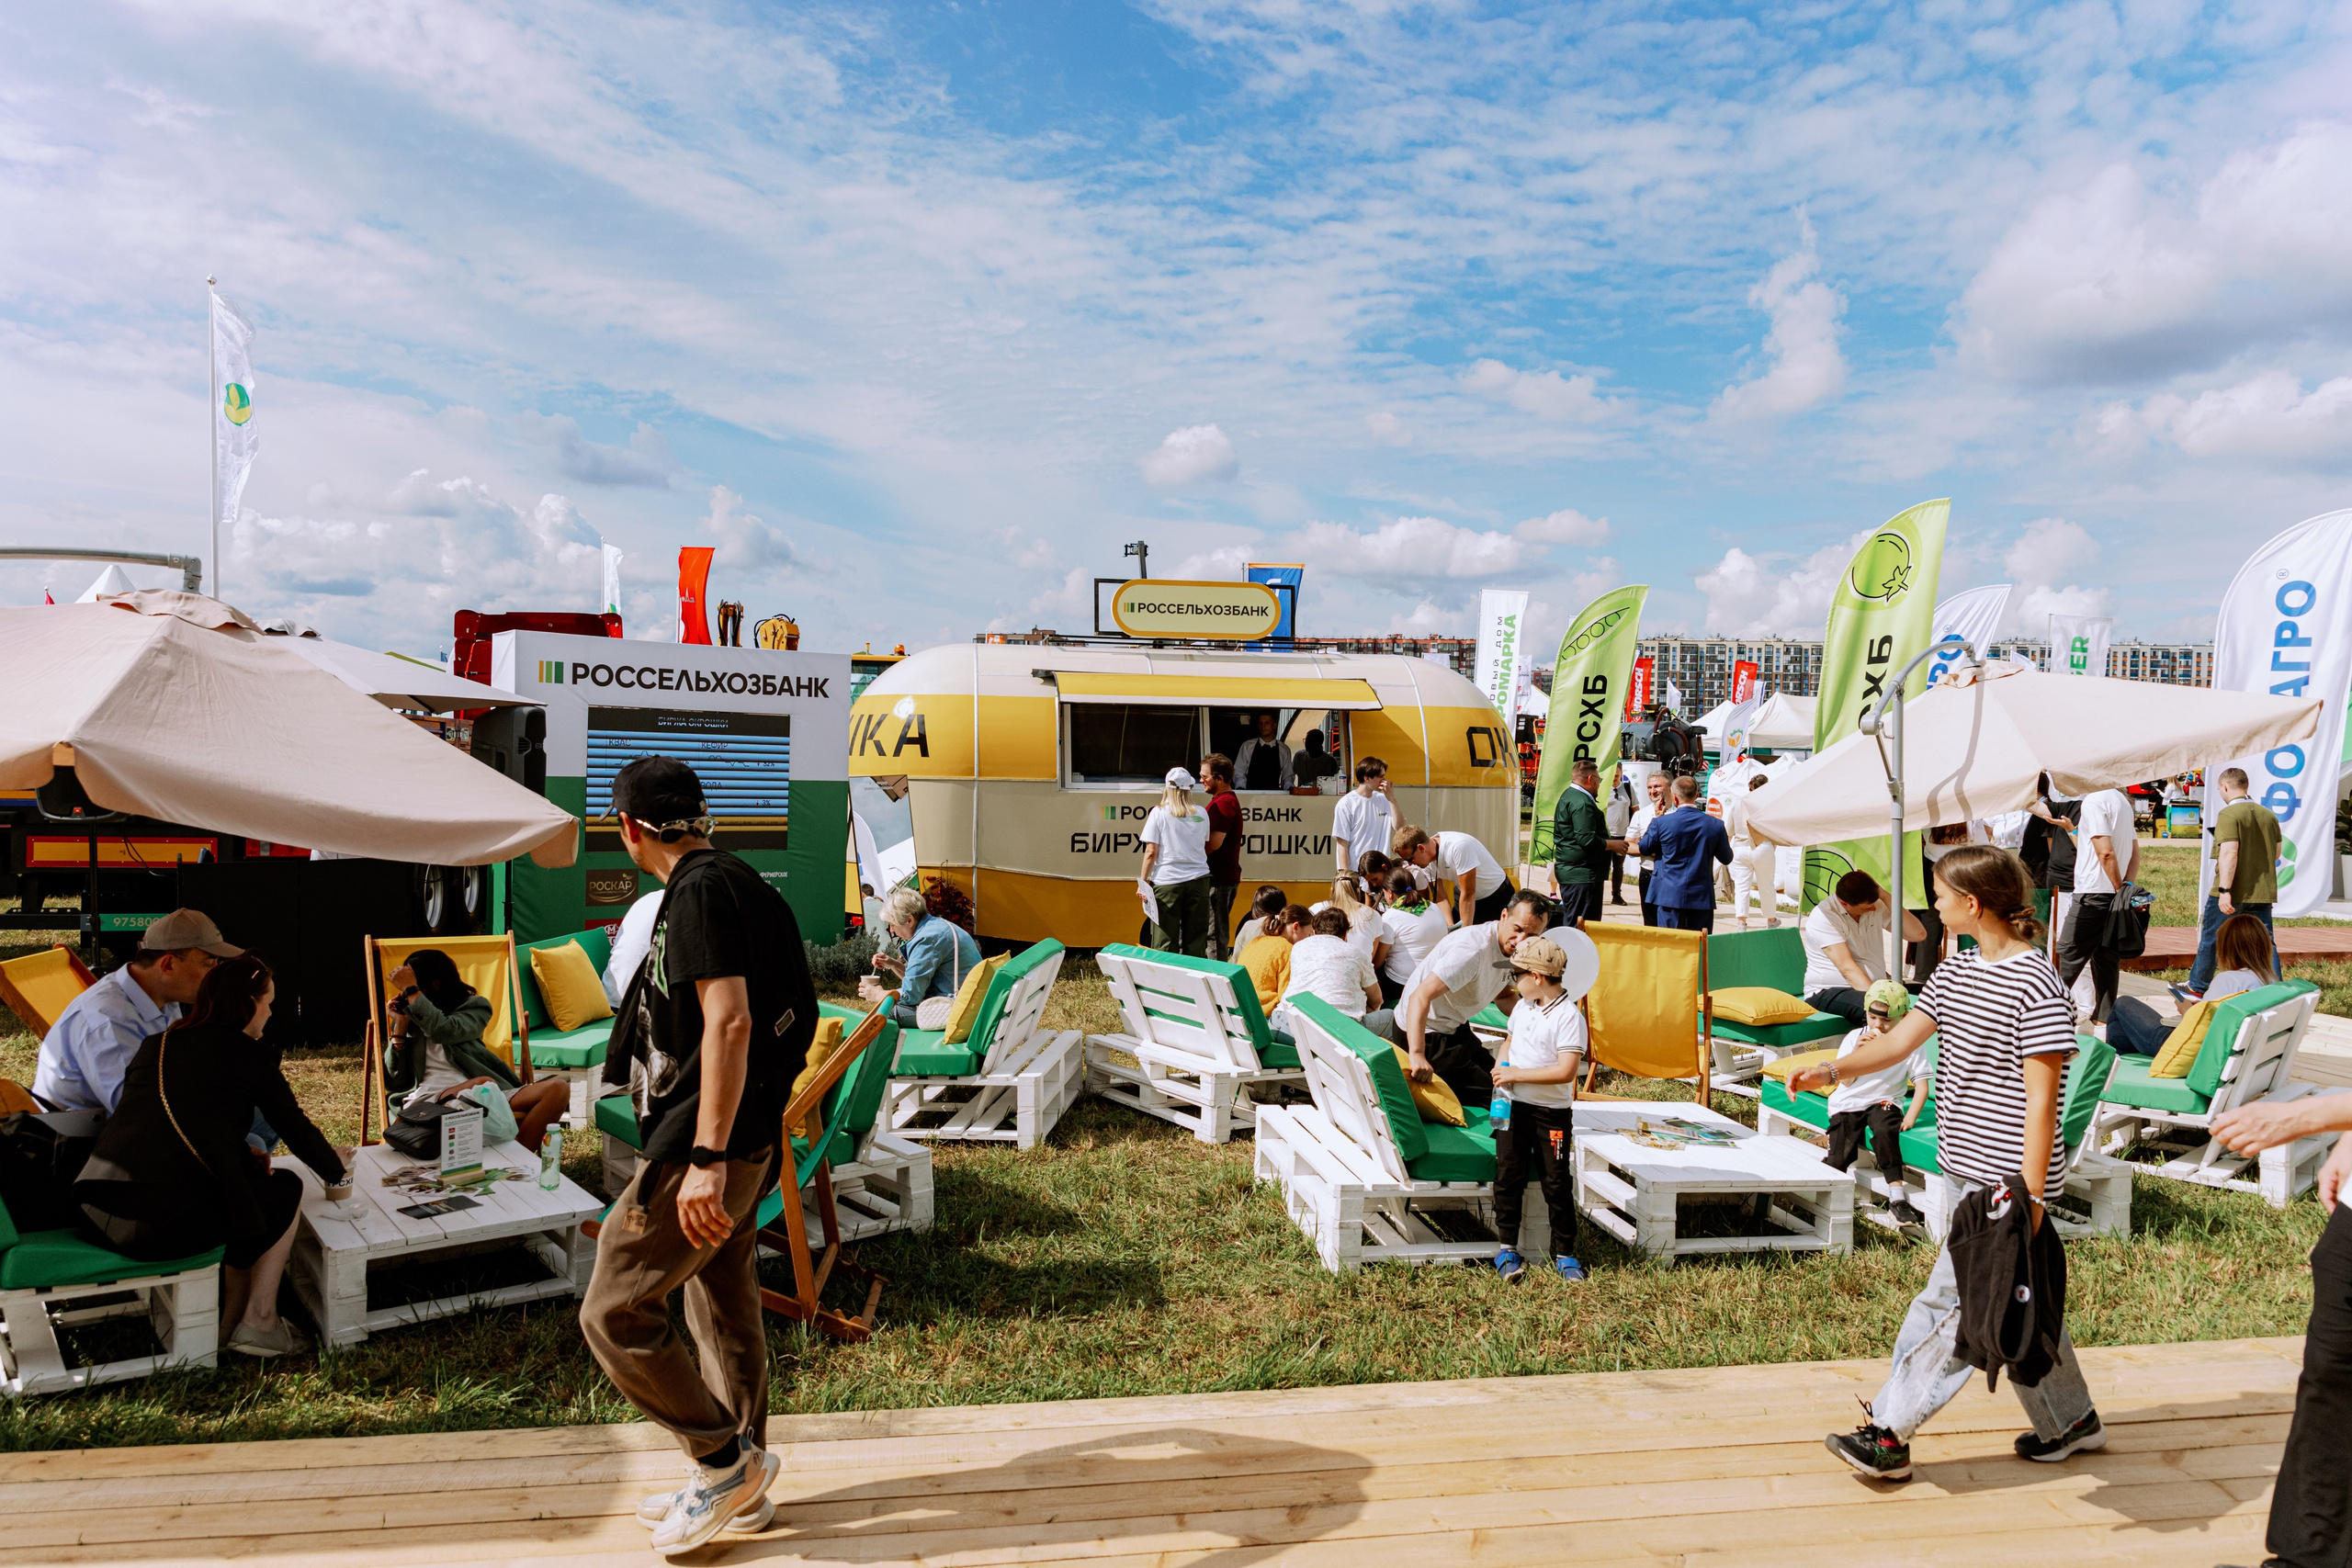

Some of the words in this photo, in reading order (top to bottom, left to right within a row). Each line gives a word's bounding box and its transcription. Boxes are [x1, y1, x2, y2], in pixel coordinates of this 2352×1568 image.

[1137, 602, 1270, 617] РОССЕЛЬХОЗБАНК
[571, 662, 831, 699] РОССЕЛЬХОЗБАНК
[1572, 674, 1608, 763] РСХБ
[608, 739, 631, 747] КВАС
[701, 741, 729, 750] КЕФИР
[589, 881, 633, 891] РОСКАР
